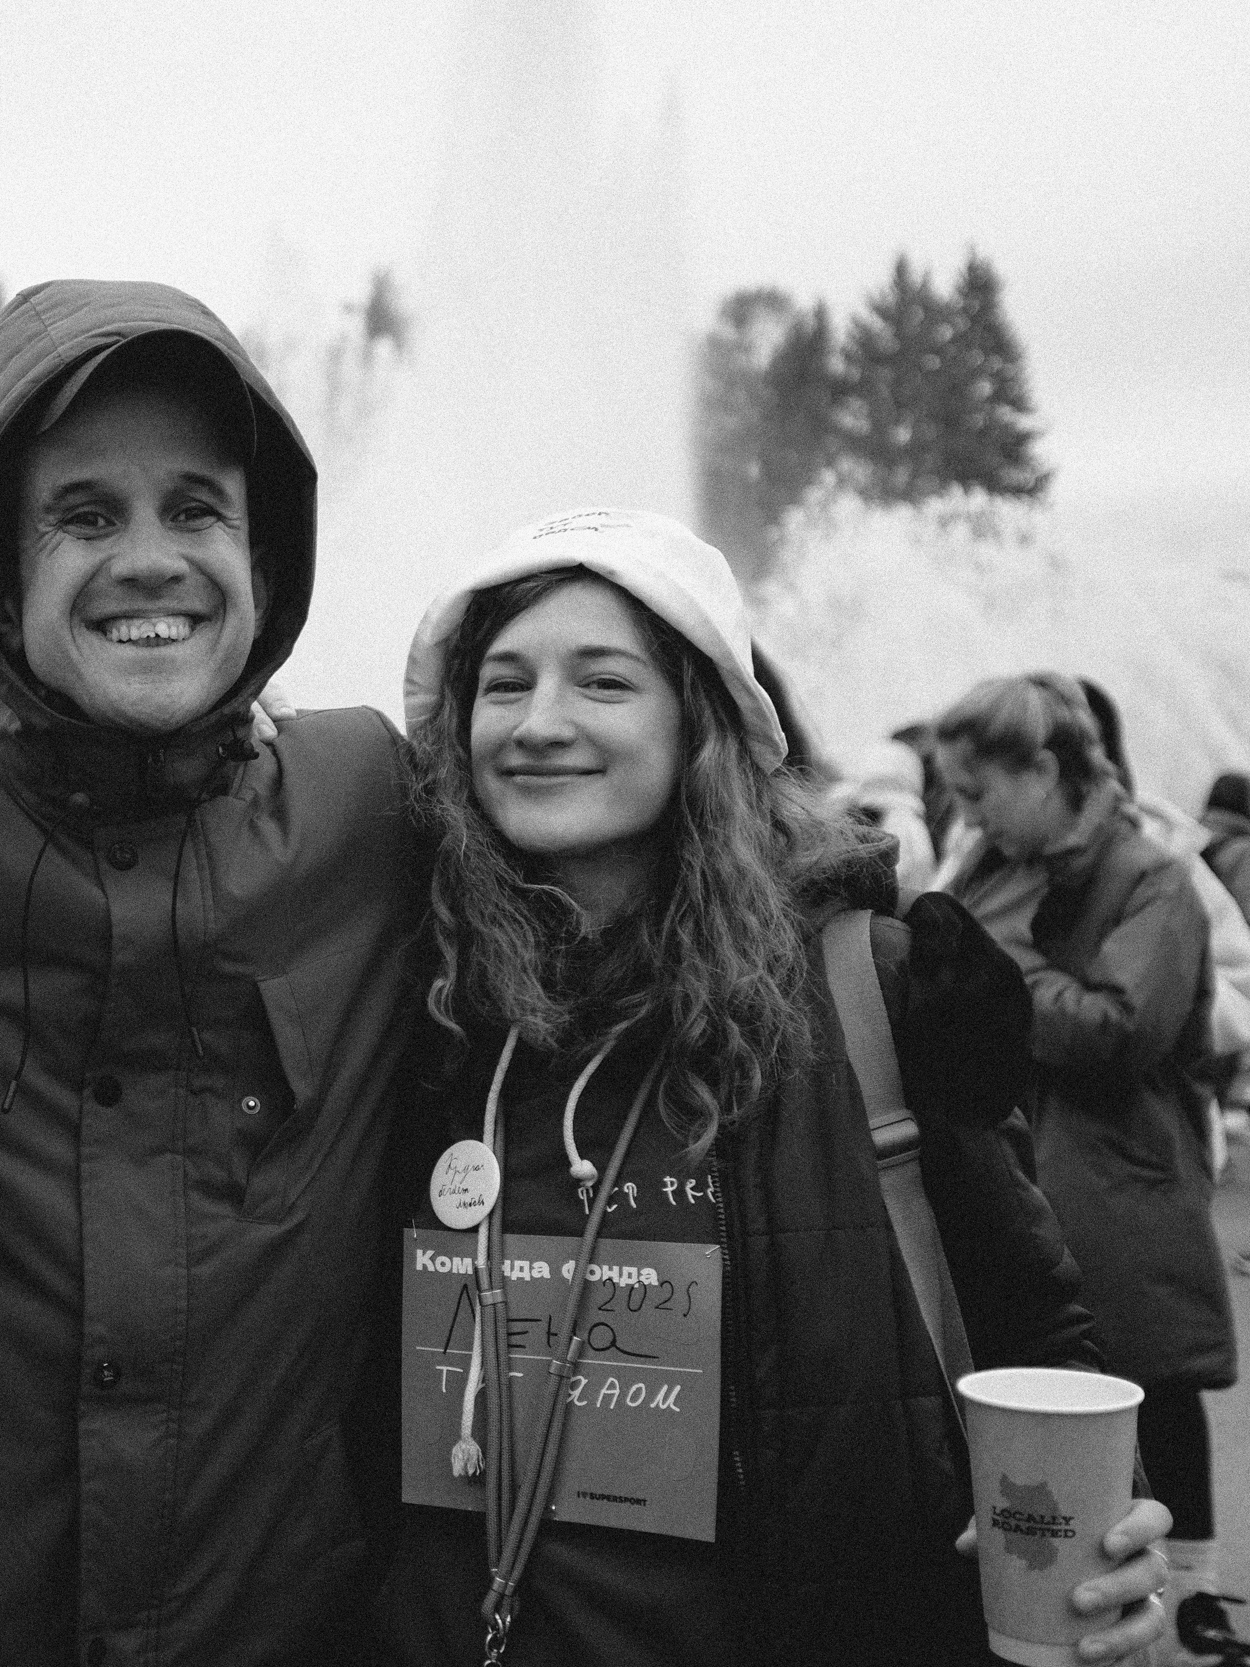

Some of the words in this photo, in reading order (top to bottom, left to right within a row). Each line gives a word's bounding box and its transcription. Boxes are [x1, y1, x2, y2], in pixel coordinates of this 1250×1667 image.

[416, 1249, 551, 1281] Комнда
[589, 1491, 648, 1507] SUPERSPORT
[991, 1505, 1076, 1526] LOCALLY
[991, 1516, 1077, 1539] ROASTED
